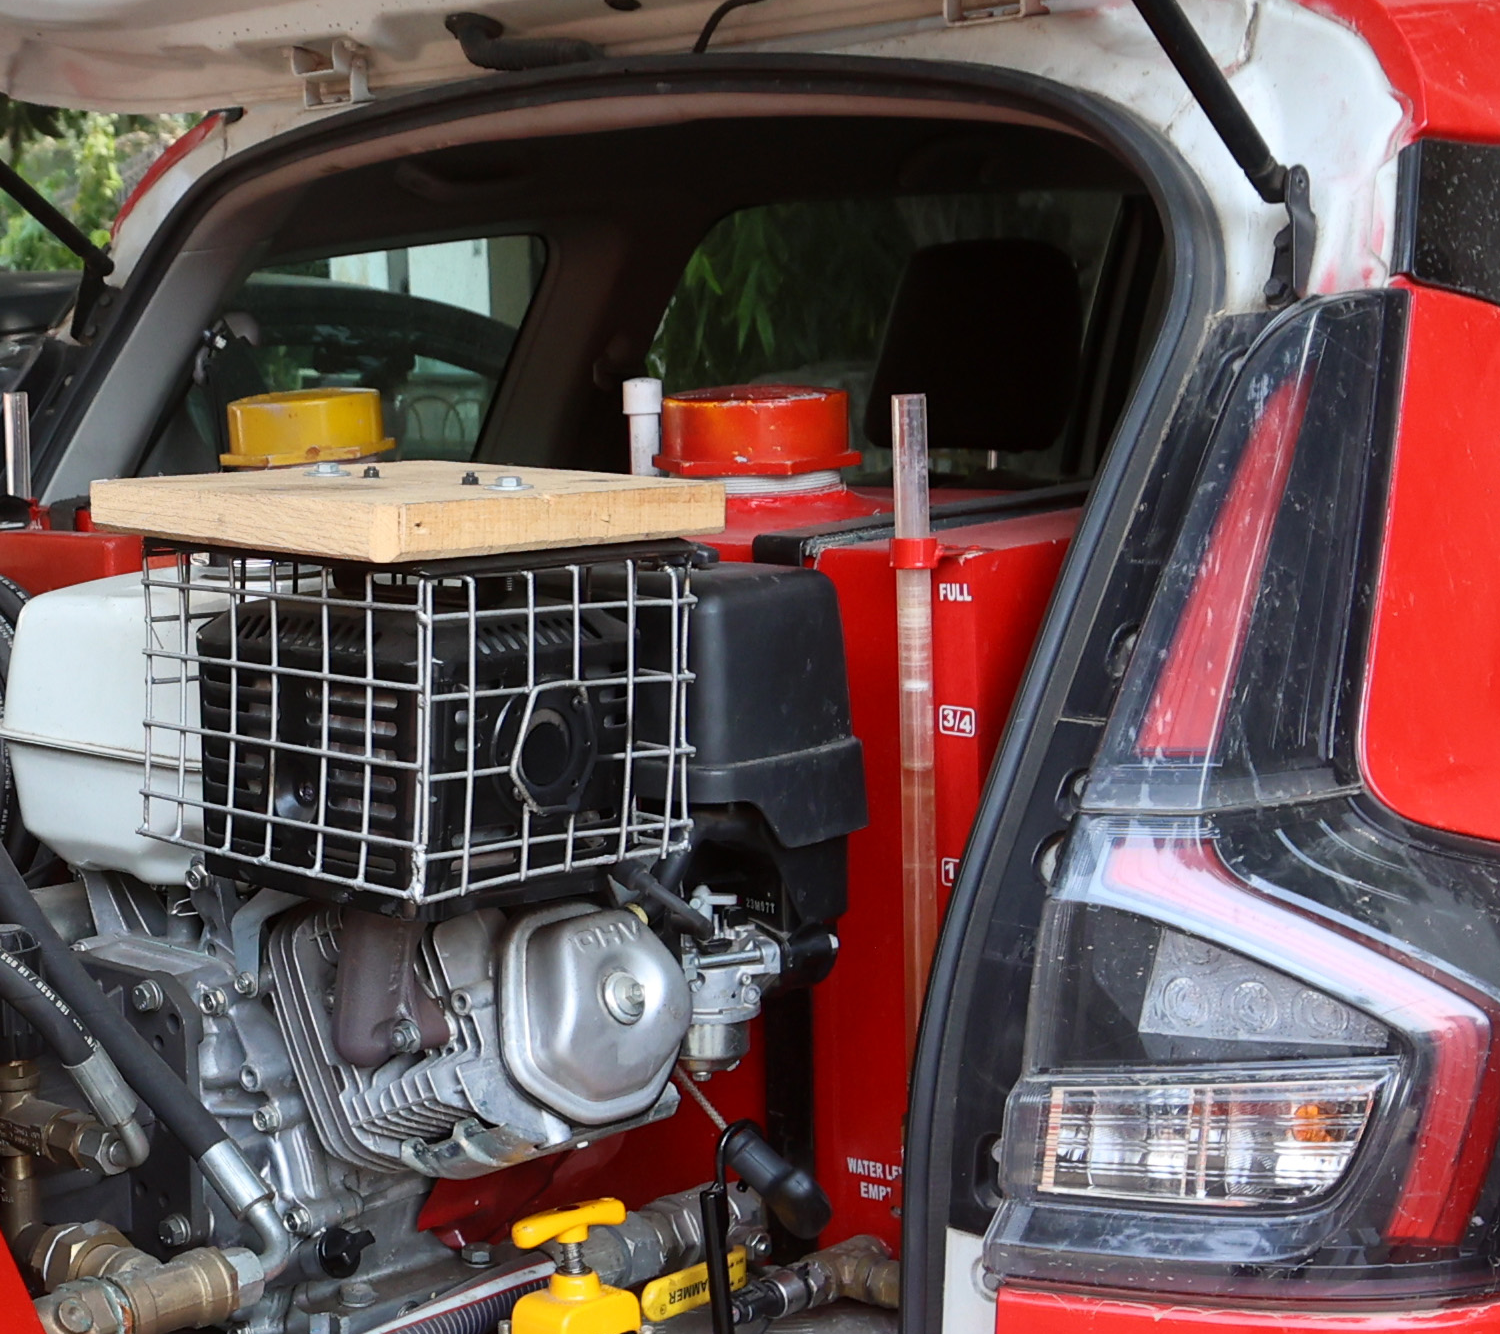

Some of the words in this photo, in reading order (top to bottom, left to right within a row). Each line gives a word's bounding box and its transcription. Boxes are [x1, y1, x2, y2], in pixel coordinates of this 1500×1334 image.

[939, 583, 972, 602] FULL
[943, 709, 972, 733] 3/4
[847, 1157, 884, 1179] WATER
[669, 1277, 711, 1305] AMMER
